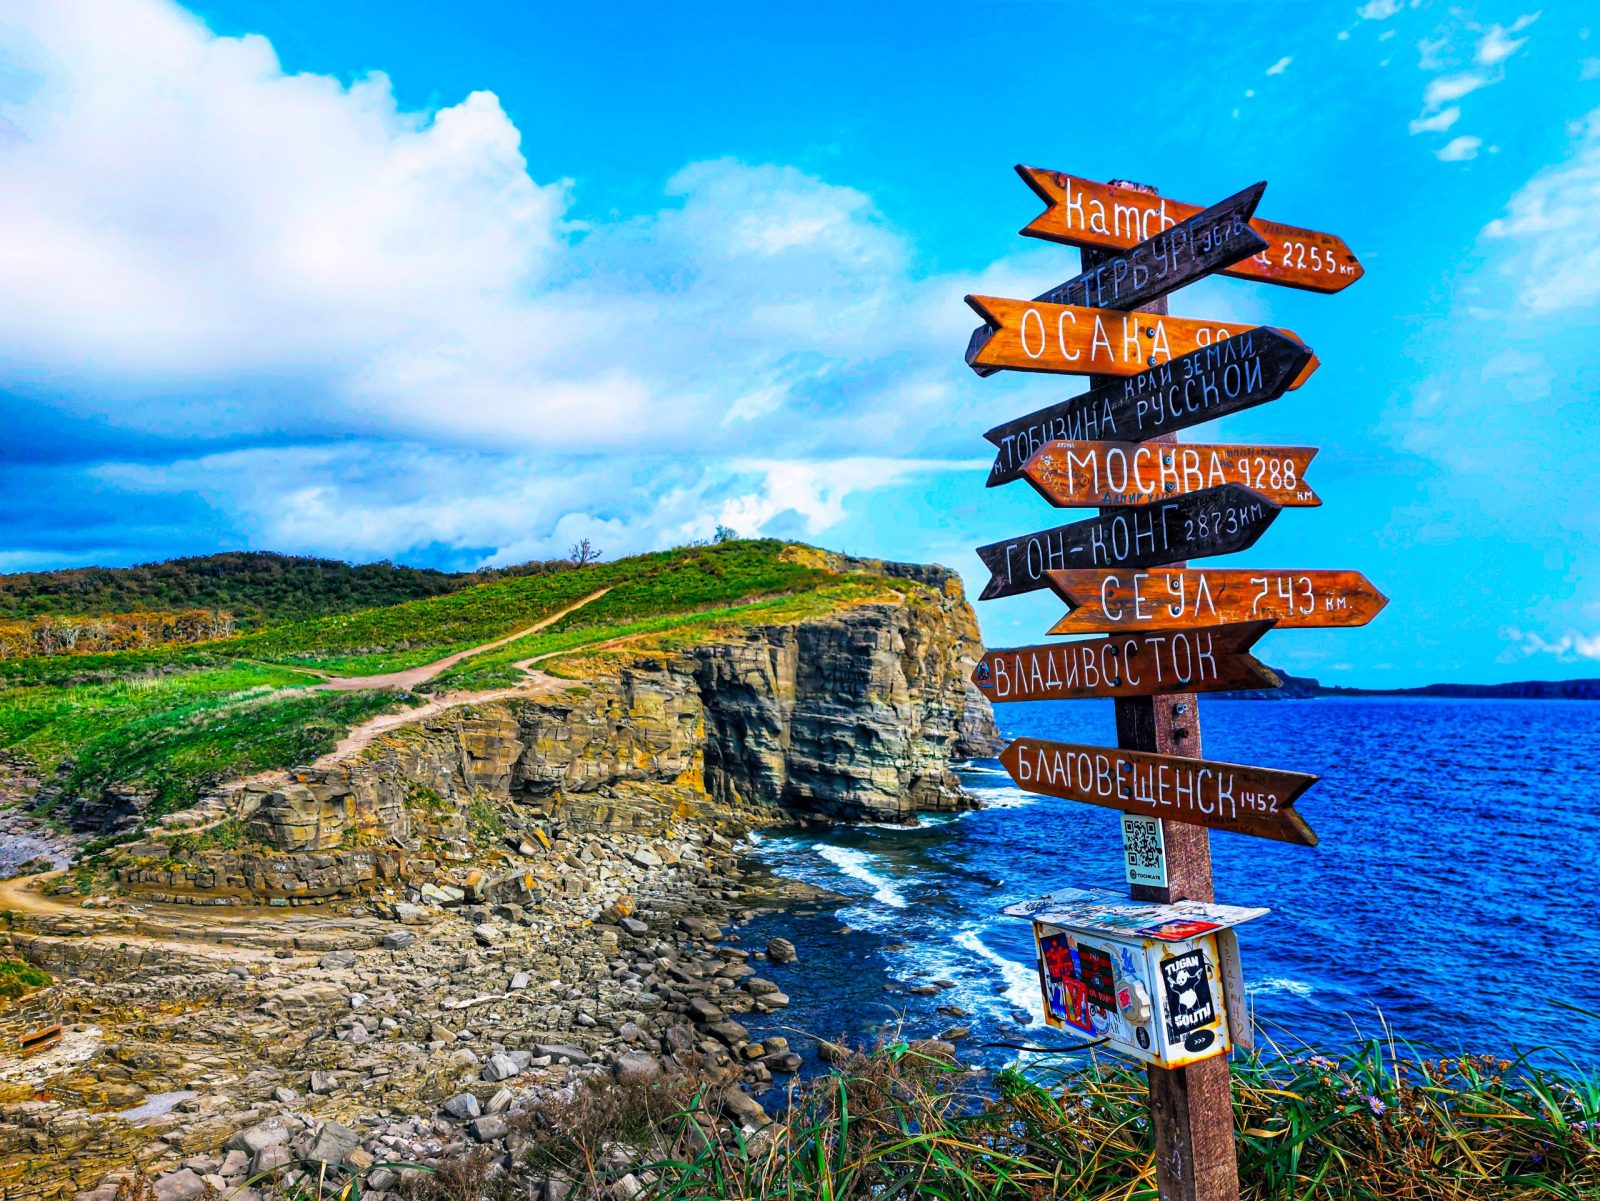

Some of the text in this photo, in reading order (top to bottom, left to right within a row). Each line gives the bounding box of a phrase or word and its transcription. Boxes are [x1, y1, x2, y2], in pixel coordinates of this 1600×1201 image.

[1283, 242, 1336, 274] 2255
[1021, 308, 1171, 364] ОСАКА
[1183, 332, 1254, 379] ЗЕМЛИ
[1002, 397, 1117, 470] ТОБИЗИНА
[1067, 447, 1227, 495] МОСКВА
[1238, 457, 1297, 490] 9288
[1006, 504, 1178, 585] ГОН-КОНГ
[1101, 573, 1216, 621] СЕУЛ
[1250, 576, 1315, 615] 743
[994, 632, 1218, 697] ВЛАДИВОСТОК
[1018, 746, 1236, 819] БЛАГОВЕЩЕНСК
[1240, 791, 1279, 813] 1452
[1164, 955, 1199, 976] TUGAN
[1174, 1002, 1211, 1028] SOUTH
